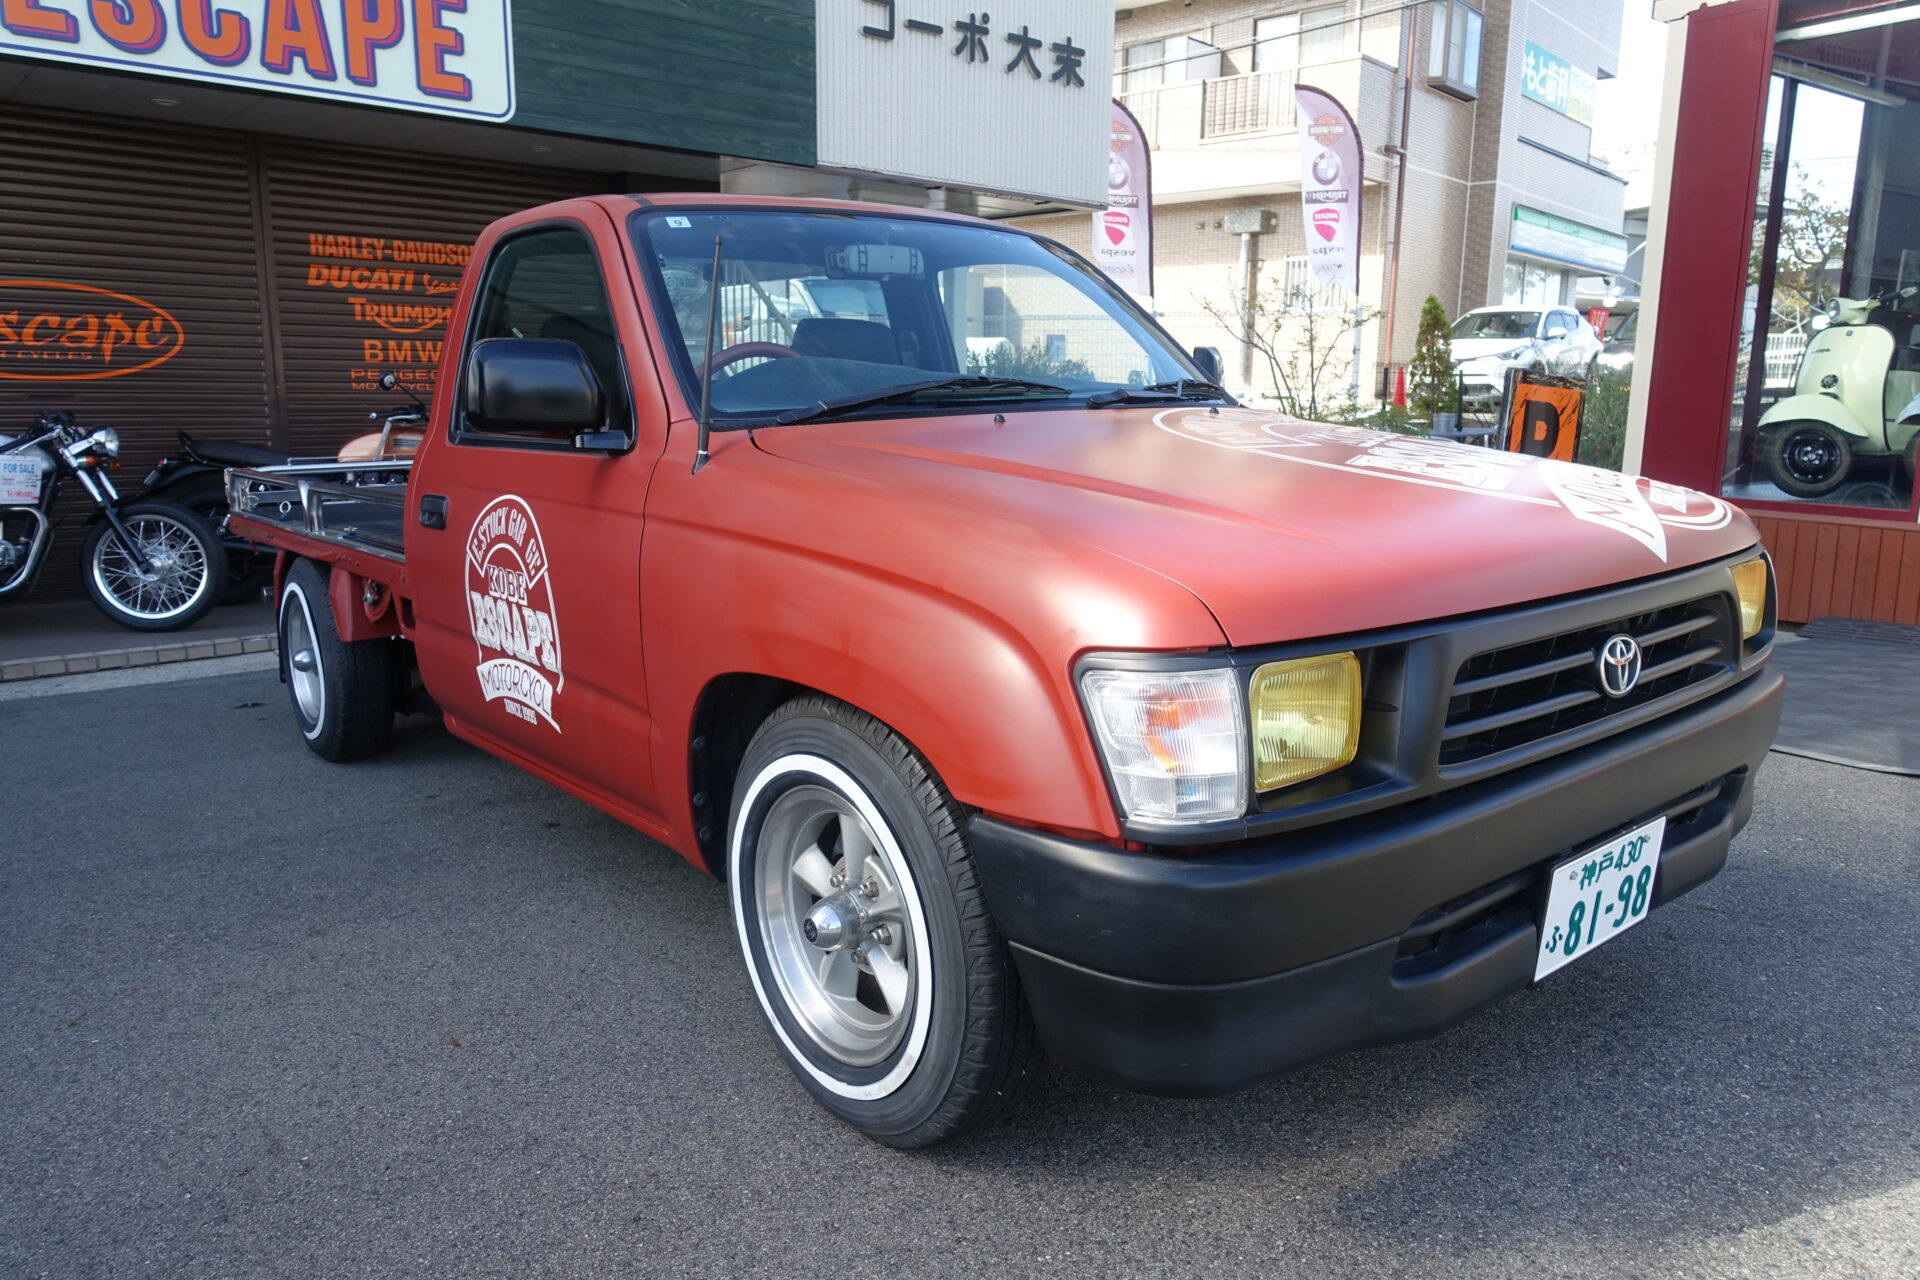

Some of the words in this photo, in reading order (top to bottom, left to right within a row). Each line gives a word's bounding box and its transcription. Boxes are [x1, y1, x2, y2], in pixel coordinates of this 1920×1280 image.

[309, 233, 474, 266] HARLEY-DAVIDSO
[307, 264, 416, 292] DUCATI
[364, 340, 443, 363] BMW
[486, 564, 528, 606] KOBE
[470, 590, 560, 674] ESCAPE
[1545, 925, 1563, 953] ふ
[1563, 865, 1651, 956] 81-98
